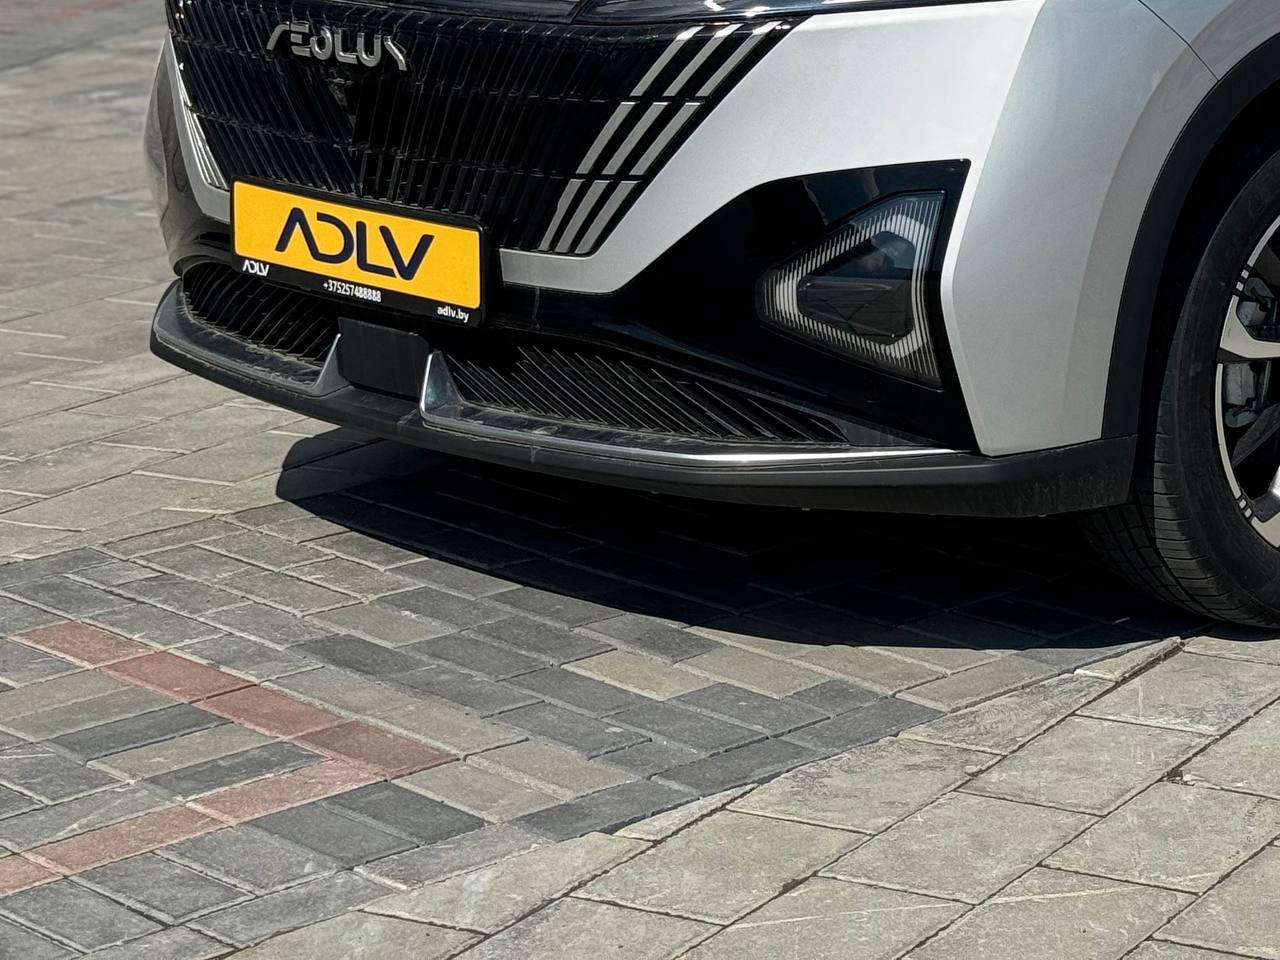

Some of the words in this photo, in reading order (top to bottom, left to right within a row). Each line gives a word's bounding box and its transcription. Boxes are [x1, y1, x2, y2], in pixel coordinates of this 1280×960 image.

[275, 207, 434, 281] ADLV
[242, 259, 269, 277] ADLV
[437, 305, 469, 323] adlv.by
